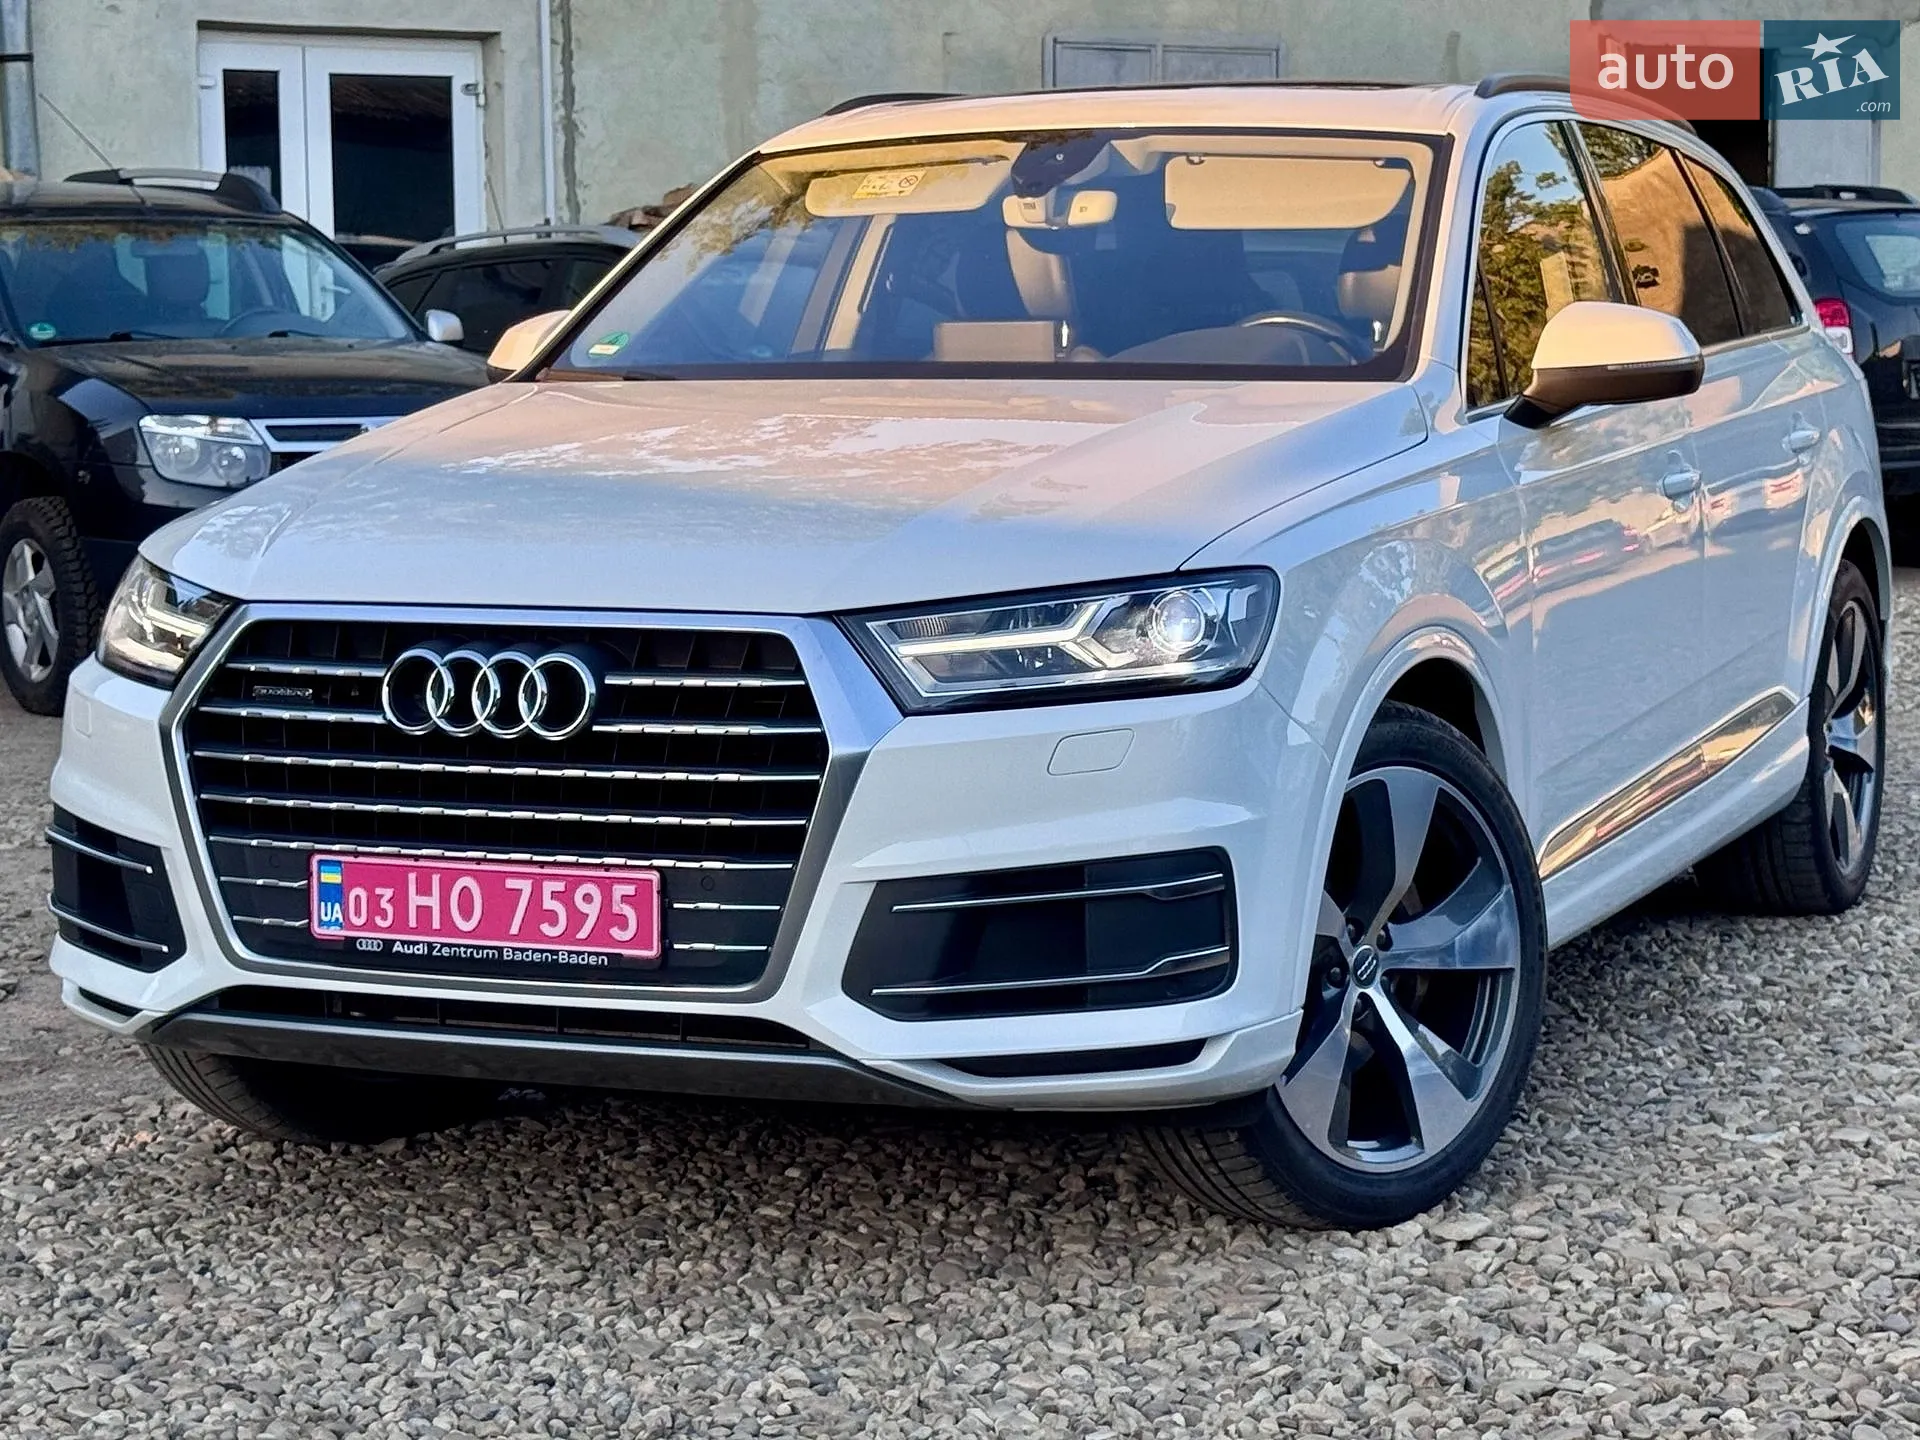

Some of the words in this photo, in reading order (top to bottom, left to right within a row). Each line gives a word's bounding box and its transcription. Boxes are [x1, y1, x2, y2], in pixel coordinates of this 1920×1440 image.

[320, 902, 343, 923] UA
[349, 887, 395, 928] 03
[407, 872, 483, 932] HO
[505, 878, 638, 942] 7595
[392, 941, 428, 956] Audi
[432, 944, 498, 960] Zentrum
[503, 948, 609, 966] Baden-Baden
